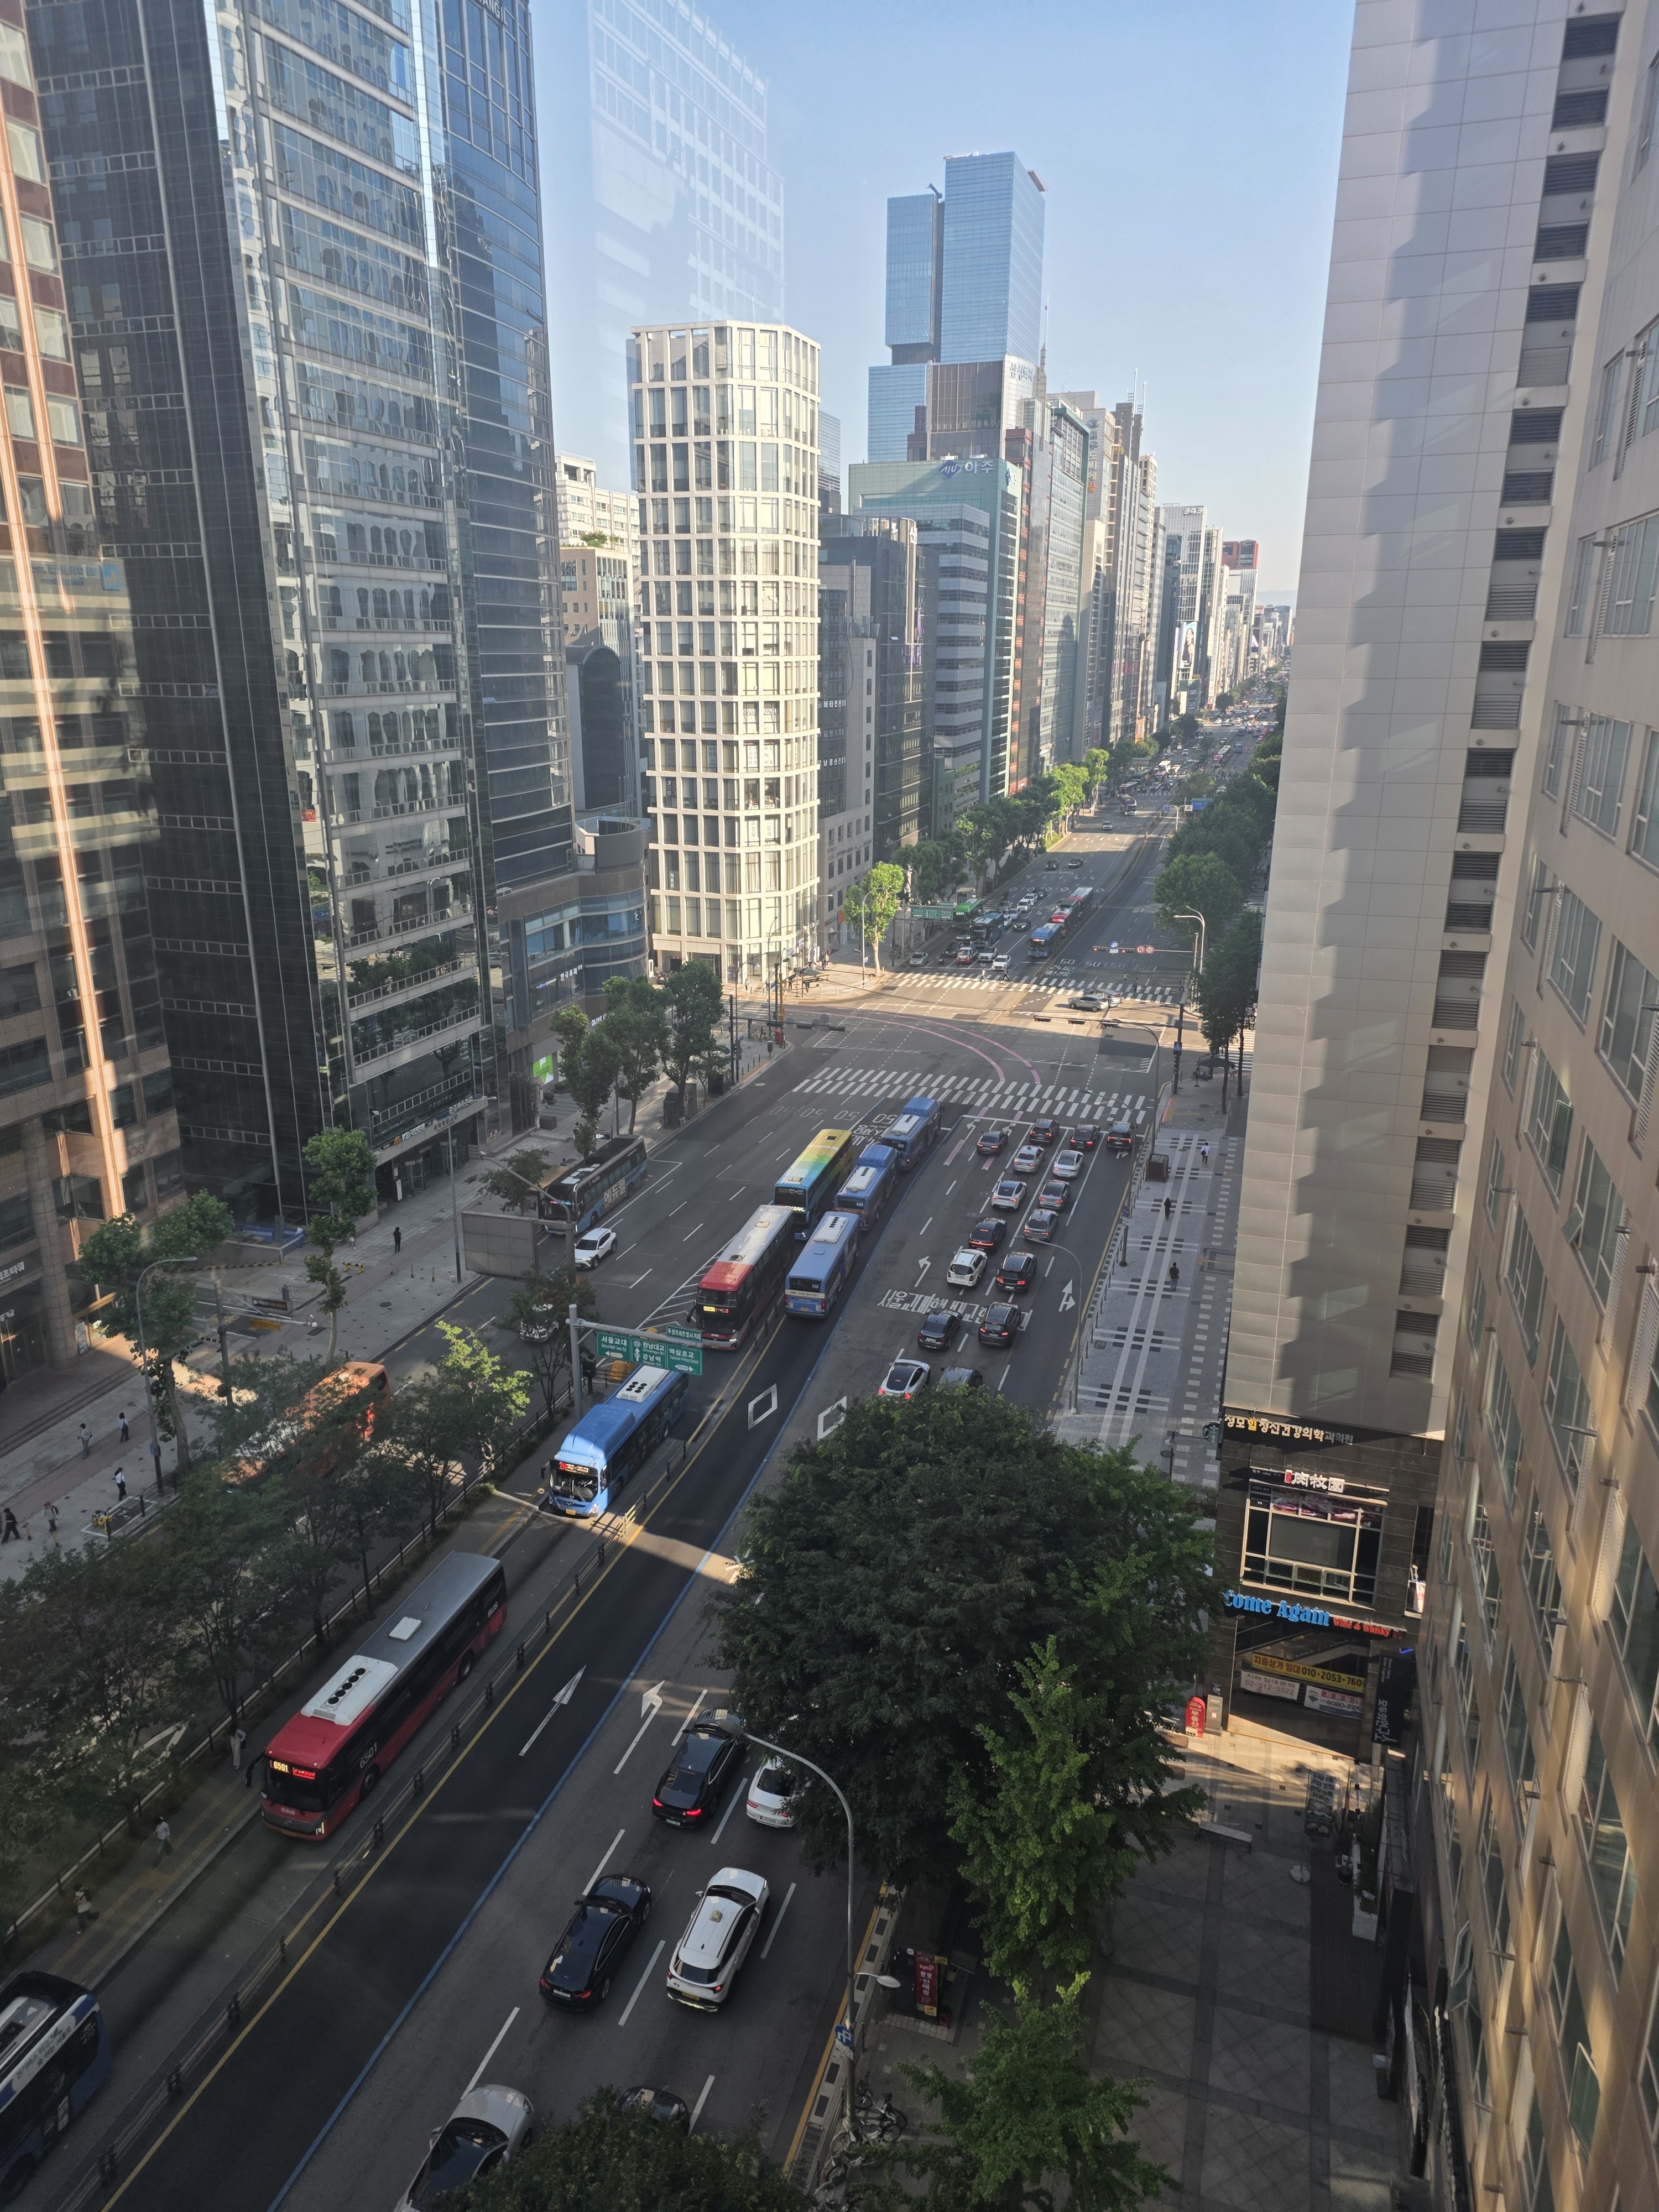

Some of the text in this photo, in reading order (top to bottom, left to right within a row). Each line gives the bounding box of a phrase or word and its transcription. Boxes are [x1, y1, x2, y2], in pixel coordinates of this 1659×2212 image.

[941, 465, 957, 474] AJU
[964, 461, 994, 474] 아주
[591, 1016, 602, 1027] OLIVE
[833, 1110, 860, 1121] 50
[872, 1113, 898, 1124] 50
[604, 1178, 625, 1204] 에듀윌
[601, 1335, 627, 1347] 서울교대
[643, 1342, 665, 1352] 한남대교
[643, 1354, 661, 1363] 강남역
[669, 1348, 695, 1358] 역삼초교
[1223, 1589, 1272, 1614] Come
[1276, 1600, 1329, 1627] Again
[1333, 1617, 1353, 1629] Wine
[1354, 1622, 1360, 1630] &
[1363, 1623, 1391, 1638] Whisky
[1285, 1663, 1301, 1674] 임대
[1245, 1679, 1295, 1695] 02-512-5022
[1191, 1710, 1199, 1728] 부동산
[1375, 1699, 1398, 1743] 모두의연구소
[359, 1743, 378, 1769] 6501
[273, 1760, 288, 1773] 6501
